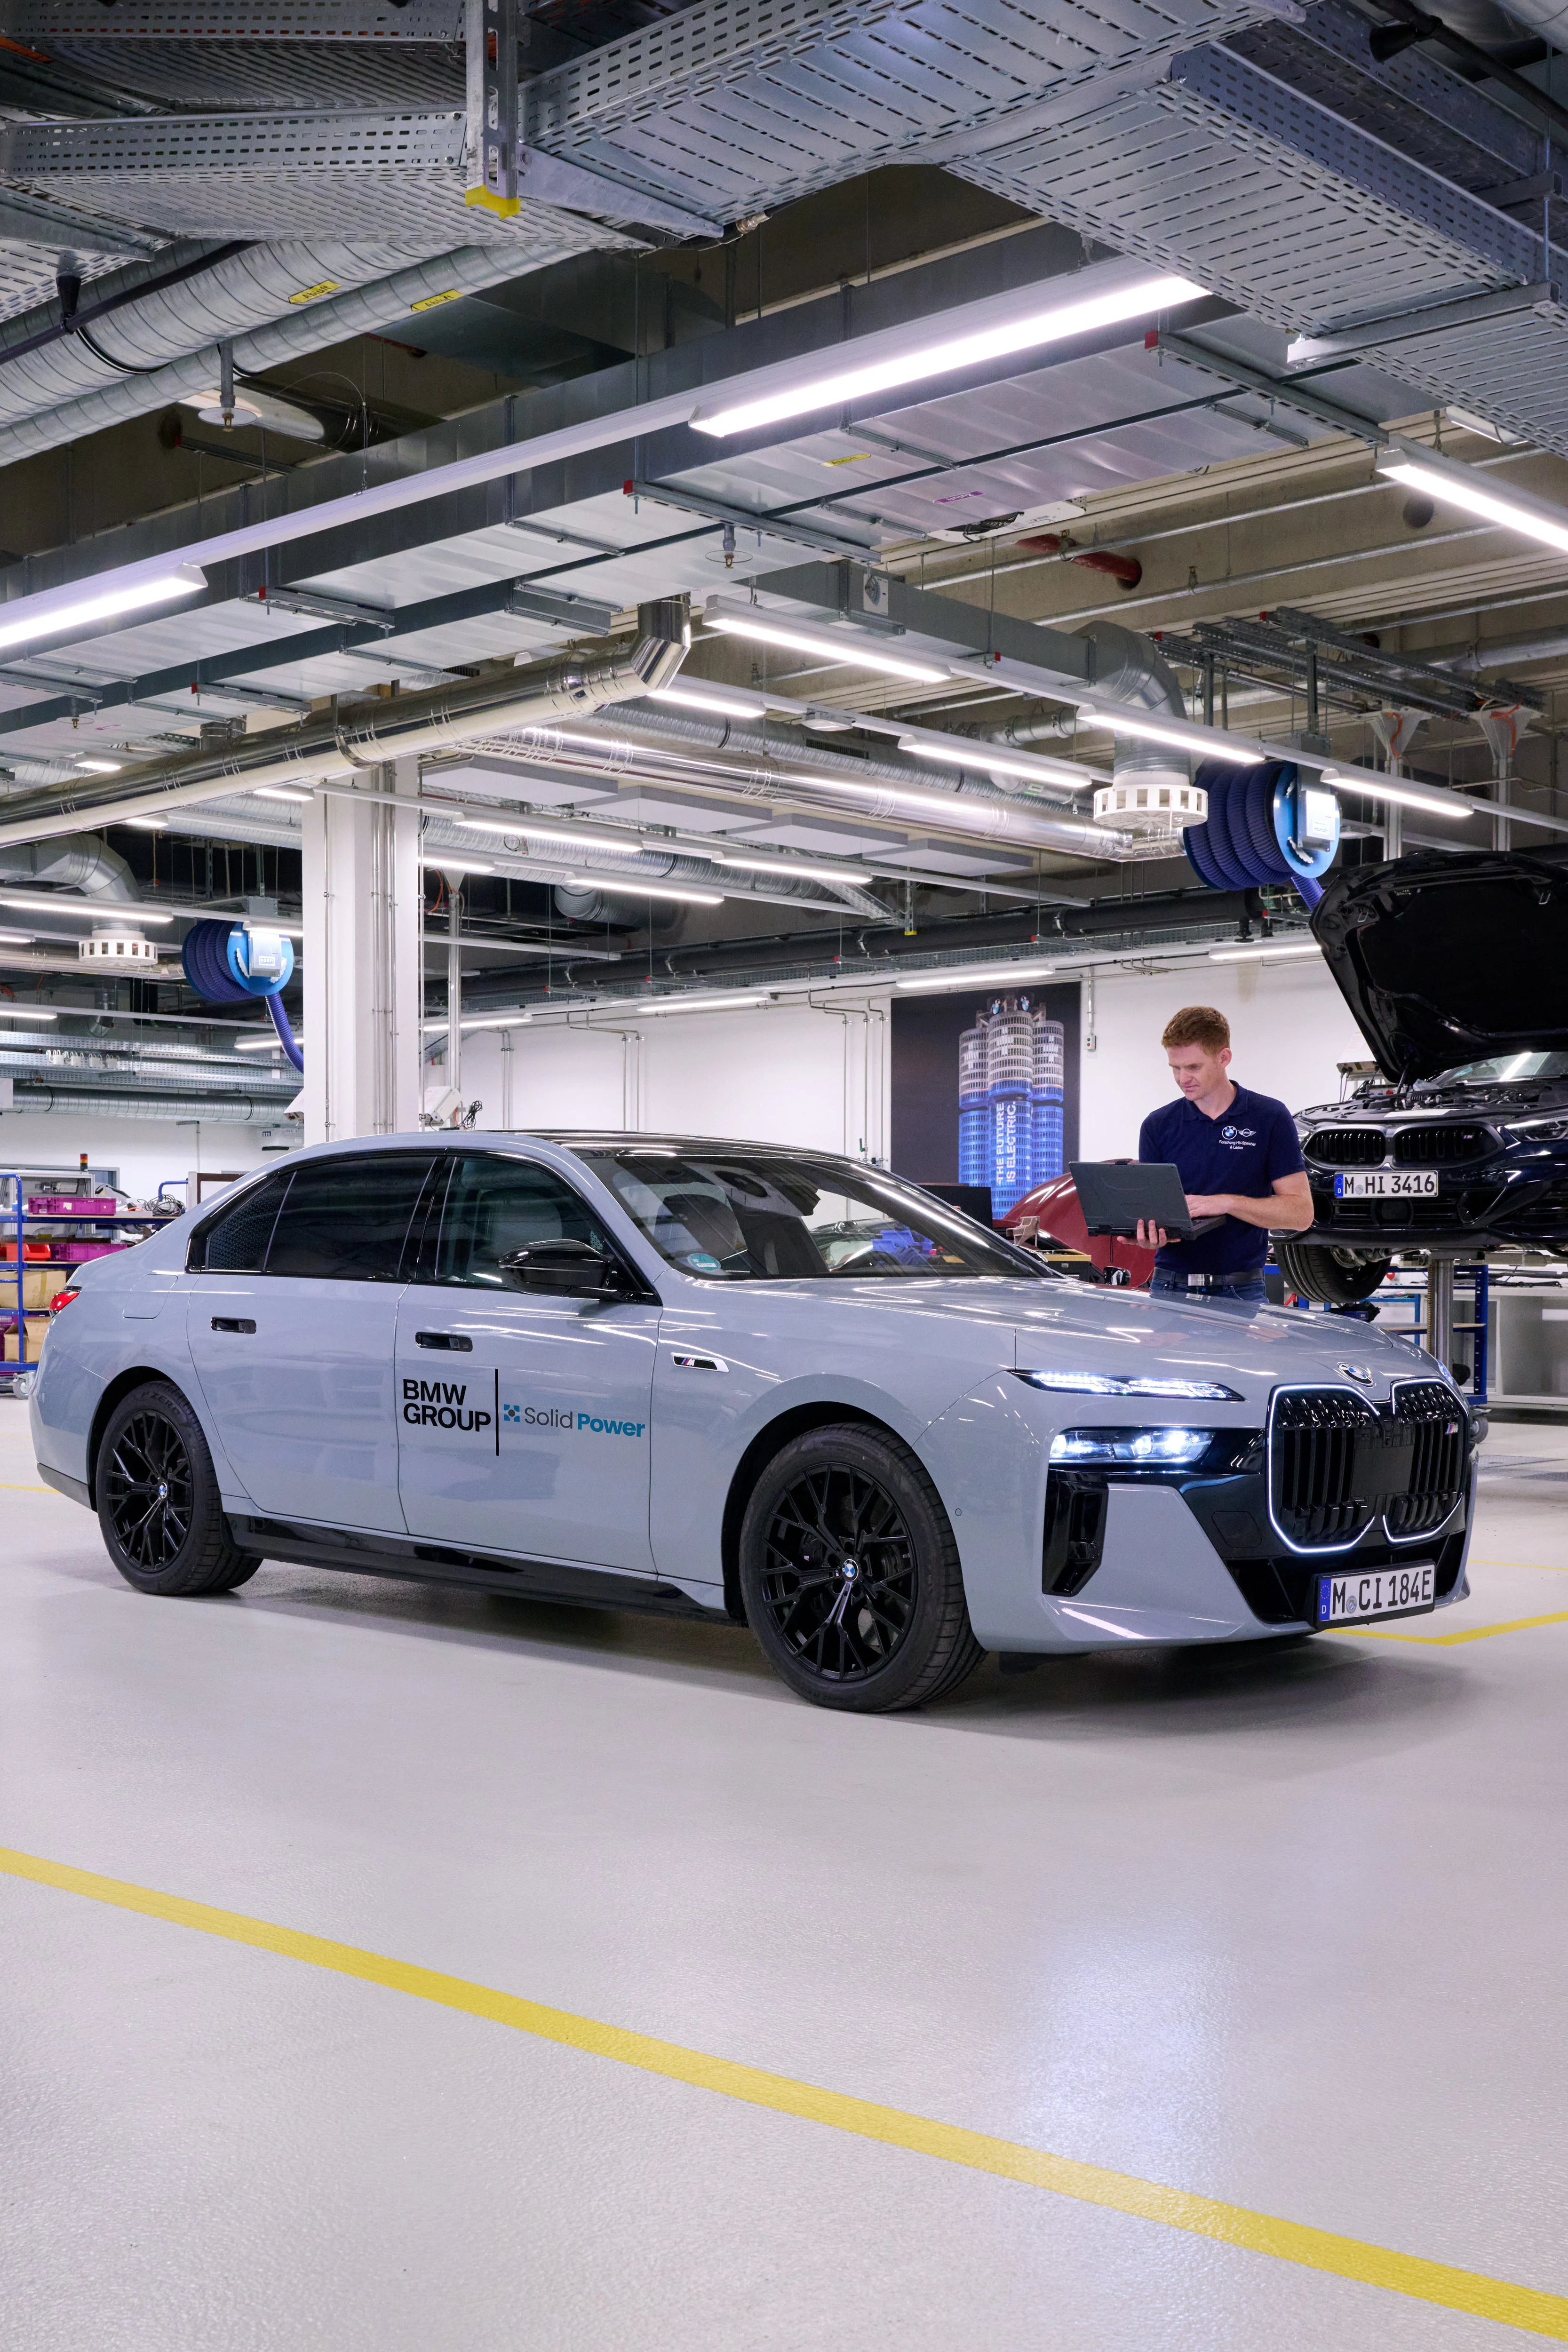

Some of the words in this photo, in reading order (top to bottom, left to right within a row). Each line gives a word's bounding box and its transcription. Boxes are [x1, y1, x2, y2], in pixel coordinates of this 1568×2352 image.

[996, 1102, 1004, 1155] FUTURE
[1006, 1101, 1016, 1168] ELECTRIC.
[1006, 1171, 1016, 1183] IS
[1345, 1176, 1354, 1194] M
[1365, 1176, 1385, 1194] HI
[1391, 1175, 1435, 1194] 3416
[403, 1379, 467, 1406] BMW
[403, 1403, 491, 1432] GROUP
[524, 1407, 573, 1429] Solid
[577, 1413, 645, 1438] Power
[1332, 1581, 1346, 1614] M
[1359, 1577, 1382, 1611] CI
[1388, 1569, 1432, 1607] 184E
